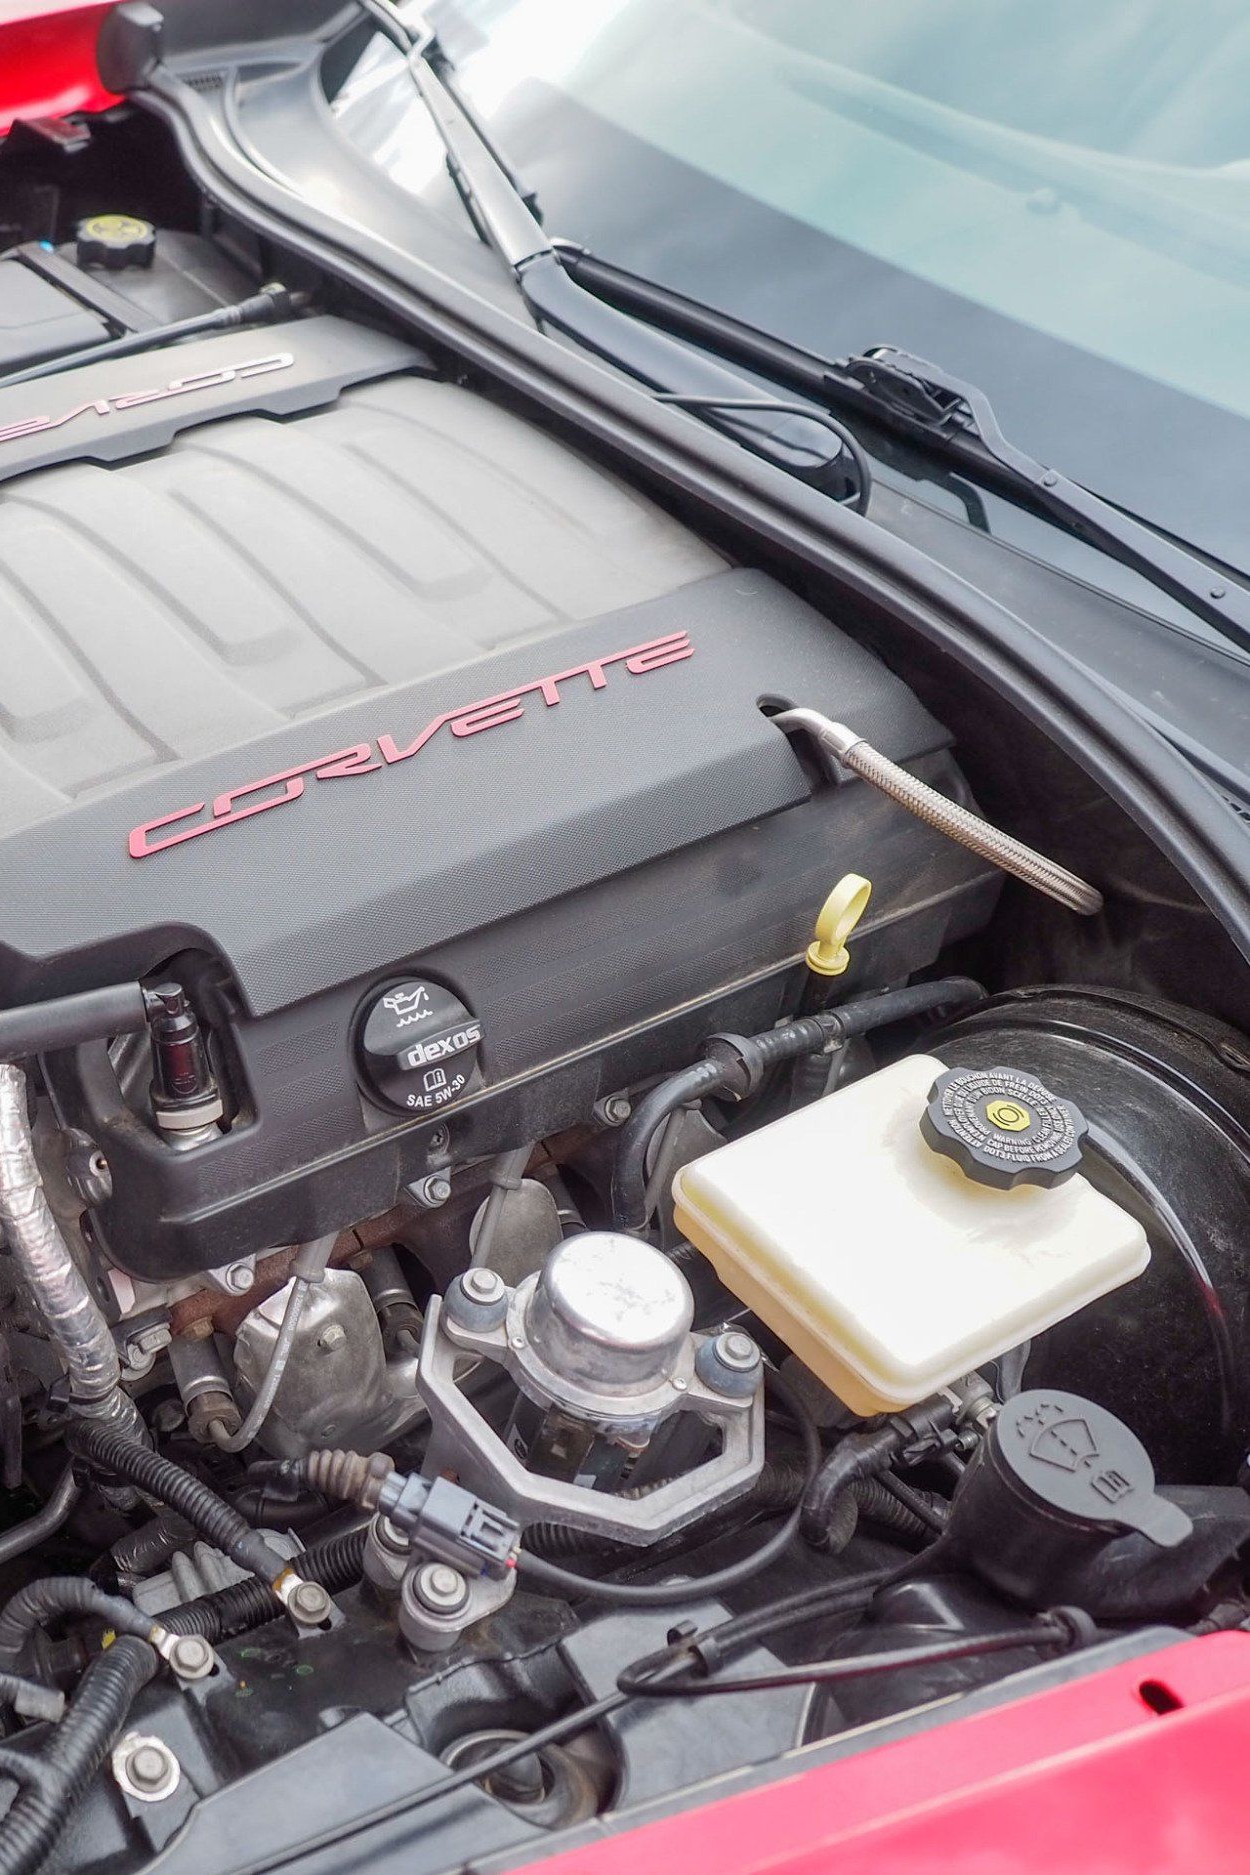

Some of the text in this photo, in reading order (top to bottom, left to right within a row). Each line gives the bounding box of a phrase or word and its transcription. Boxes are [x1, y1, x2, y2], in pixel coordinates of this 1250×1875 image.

[128, 630, 696, 859] CORVETTE
[407, 1023, 481, 1067] dexos
[406, 1074, 465, 1107] SAE 5W-30
[953, 1070, 988, 1086] BOUCHON
[986, 1072, 1014, 1082] AVANT
[962, 1078, 992, 1092] LIQUIDE
[1003, 1079, 1030, 1094] FREIN
[1027, 1089, 1050, 1105] DOT3
[978, 1085, 1005, 1095] BIDON
[985, 1138, 1003, 1150] CAP
[1002, 1143, 1037, 1154] BEFORE
[1051, 1119, 1064, 1132] USE
[1029, 1125, 1051, 1144] CLEAN
[981, 1144, 1006, 1159] DOT3
[1005, 1151, 1032, 1162] FLUID
[1028, 1149, 1056, 1162] FROM
